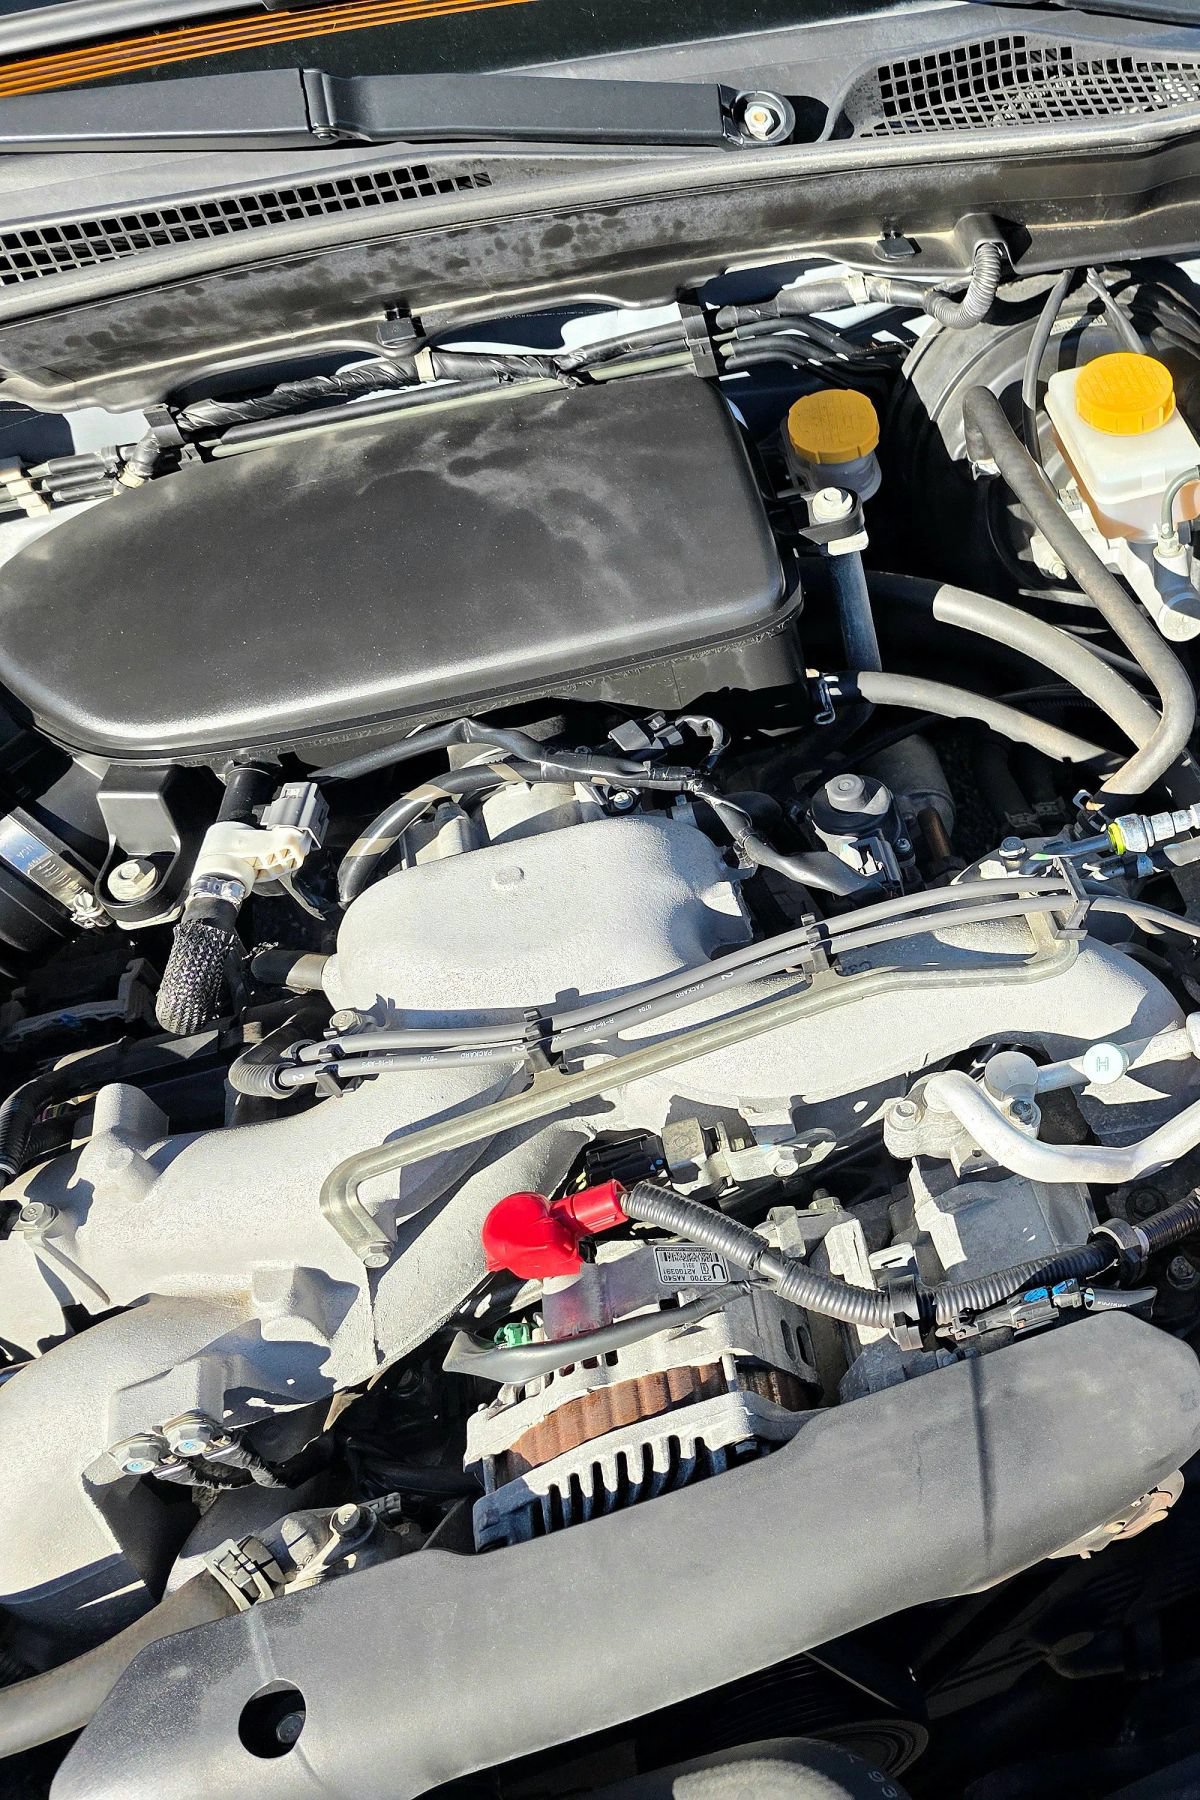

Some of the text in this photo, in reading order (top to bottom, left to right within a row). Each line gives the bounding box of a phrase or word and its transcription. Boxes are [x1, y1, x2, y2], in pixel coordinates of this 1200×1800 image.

[675, 982, 705, 999] PACKARD
[460, 1049, 493, 1059] PACKARD
[1096, 1056, 1110, 1072] H
[711, 1263, 726, 1279] U
